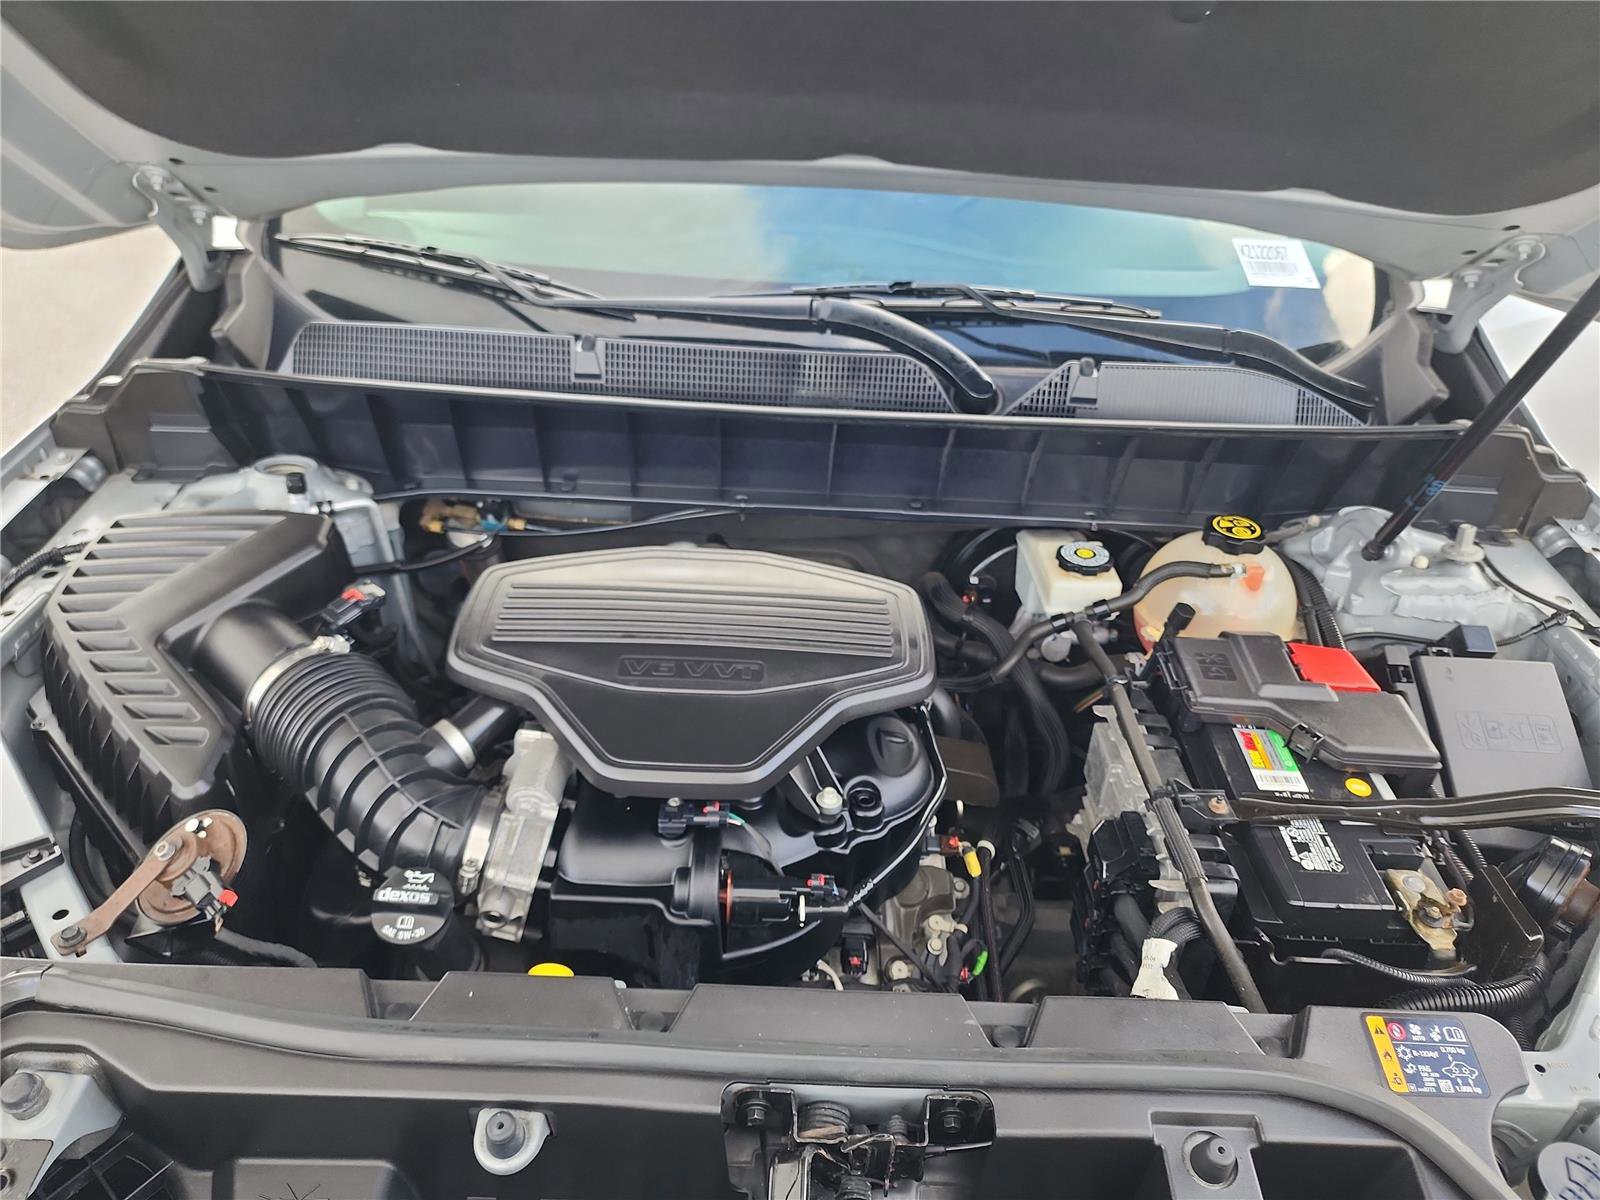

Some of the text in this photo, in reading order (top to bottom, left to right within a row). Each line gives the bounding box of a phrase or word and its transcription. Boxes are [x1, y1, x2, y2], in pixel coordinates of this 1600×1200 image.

[624, 659, 760, 679] V6 VVT
[377, 887, 431, 904] dexos
